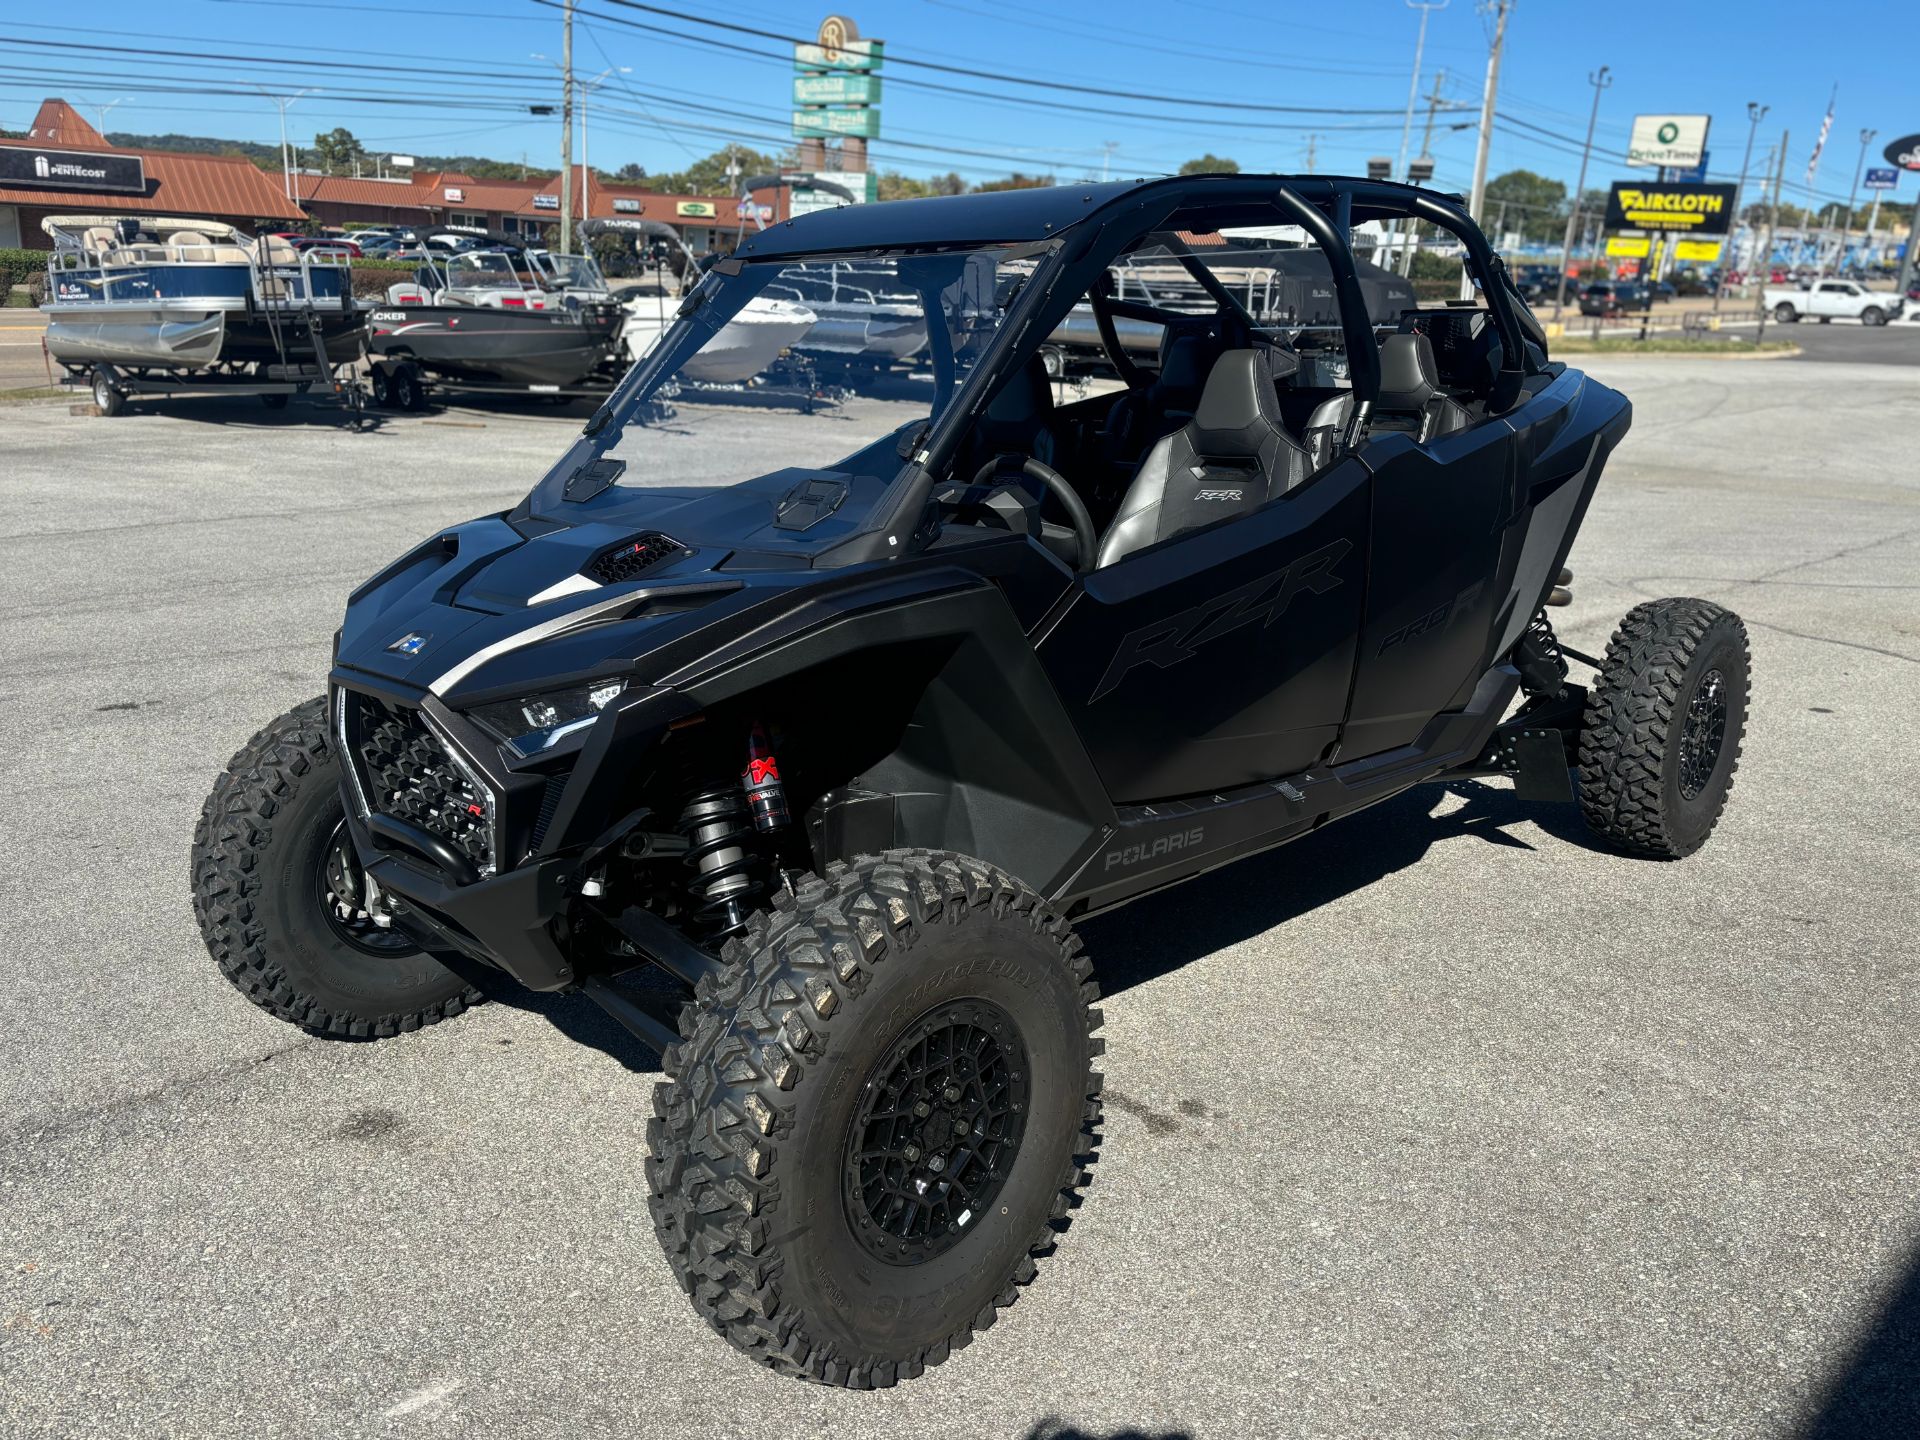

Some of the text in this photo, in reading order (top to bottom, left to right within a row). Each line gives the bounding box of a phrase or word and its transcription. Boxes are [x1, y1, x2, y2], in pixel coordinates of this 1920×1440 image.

[1629, 148, 1699, 161] DriveTime
[50, 167, 106, 178] PENTECOST
[1618, 190, 1723, 213] FAIRCLOTH
[603, 219, 641, 229] TAHOE
[1194, 489, 1243, 501] RZR
[1088, 538, 1353, 705] RZR
[444, 795, 469, 810] PRO
[1105, 827, 1204, 872] POLARIS
